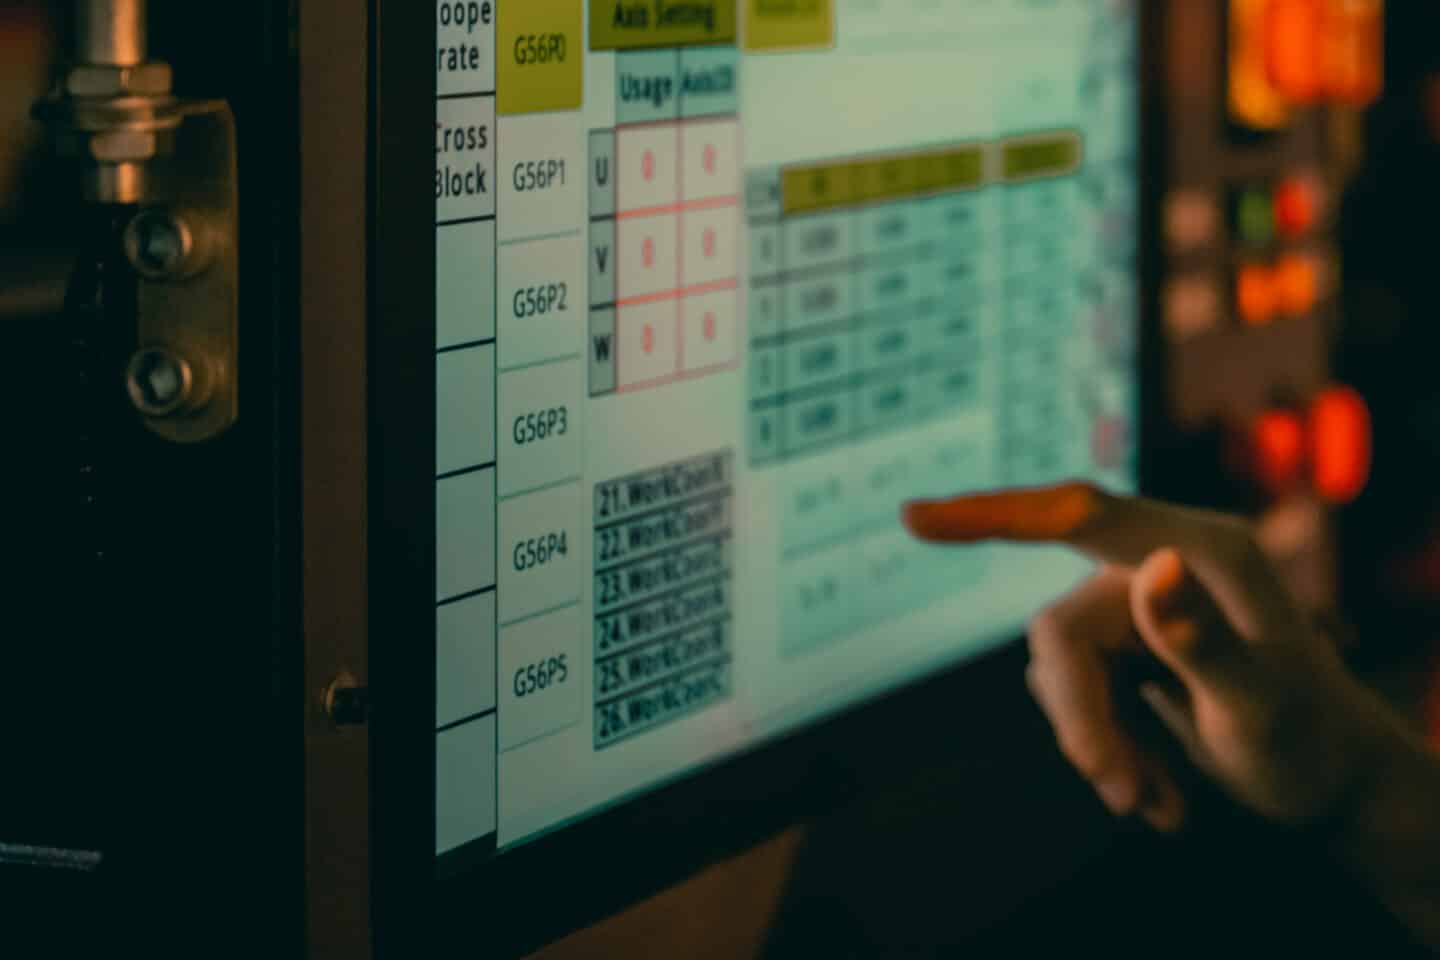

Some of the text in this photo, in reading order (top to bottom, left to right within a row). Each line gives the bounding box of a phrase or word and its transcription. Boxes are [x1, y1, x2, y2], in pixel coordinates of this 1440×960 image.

[440, 0, 491, 33] oope
[438, 43, 480, 71] rate
[513, 33, 567, 65] G56P0
[620, 73, 673, 108] Usage
[512, 159, 566, 191] G56P1
[595, 157, 609, 186] U
[595, 246, 609, 274] V
[512, 282, 568, 318] G56P2
[593, 334, 611, 363] W
[512, 406, 568, 445] G56P3
[512, 530, 568, 571] G56P4
[512, 654, 568, 698] G56P5
